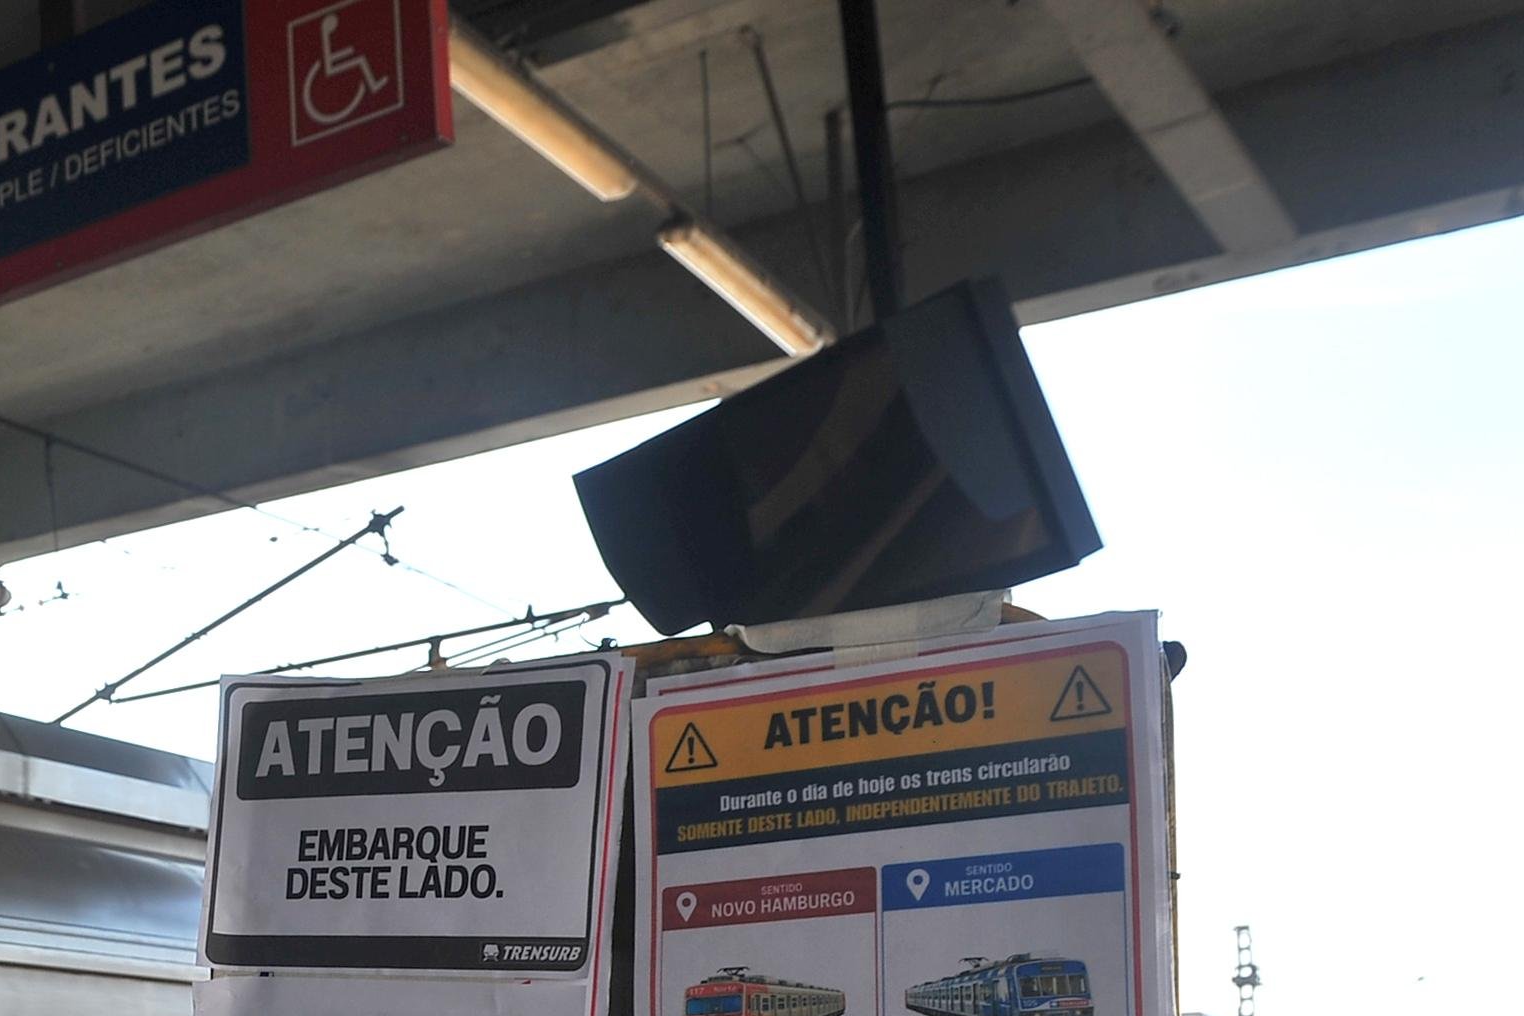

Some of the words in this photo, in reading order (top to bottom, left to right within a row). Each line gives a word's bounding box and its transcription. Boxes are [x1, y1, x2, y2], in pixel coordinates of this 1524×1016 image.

[49, 165, 59, 189] /
[64, 89, 241, 182] DEFICIENTES
[762, 680, 996, 751] ATENÇÃO!
[254, 693, 563, 788] ATENÇÃO
[719, 789, 782, 813] Durante
[786, 790, 798, 804] o
[802, 783, 828, 803] dia
[832, 780, 854, 799] de
[857, 774, 895, 796] hoje
[900, 772, 922, 790] os
[926, 766, 973, 787] trens
[977, 753, 1071, 781] circularão
[677, 817, 743, 842] SOMENTE
[747, 813, 793, 834] DESTE
[845, 786, 1012, 822] INDEPENDENTEMENTE
[1016, 782, 1041, 801] DO
[1046, 773, 1124, 799] TRAJETO.
[297, 824, 490, 867] EMBARQUE
[285, 865, 391, 900] DESTE
[398, 864, 505, 899] LADO.
[944, 874, 1034, 897] MERCADO
[966, 862, 1013, 876] SENTIDO
[711, 899, 757, 918] NOVO
[760, 890, 855, 914] HAMBURGO
[760, 882, 803, 896] SENTIDO
[502, 944, 582, 962] TRENSURB
